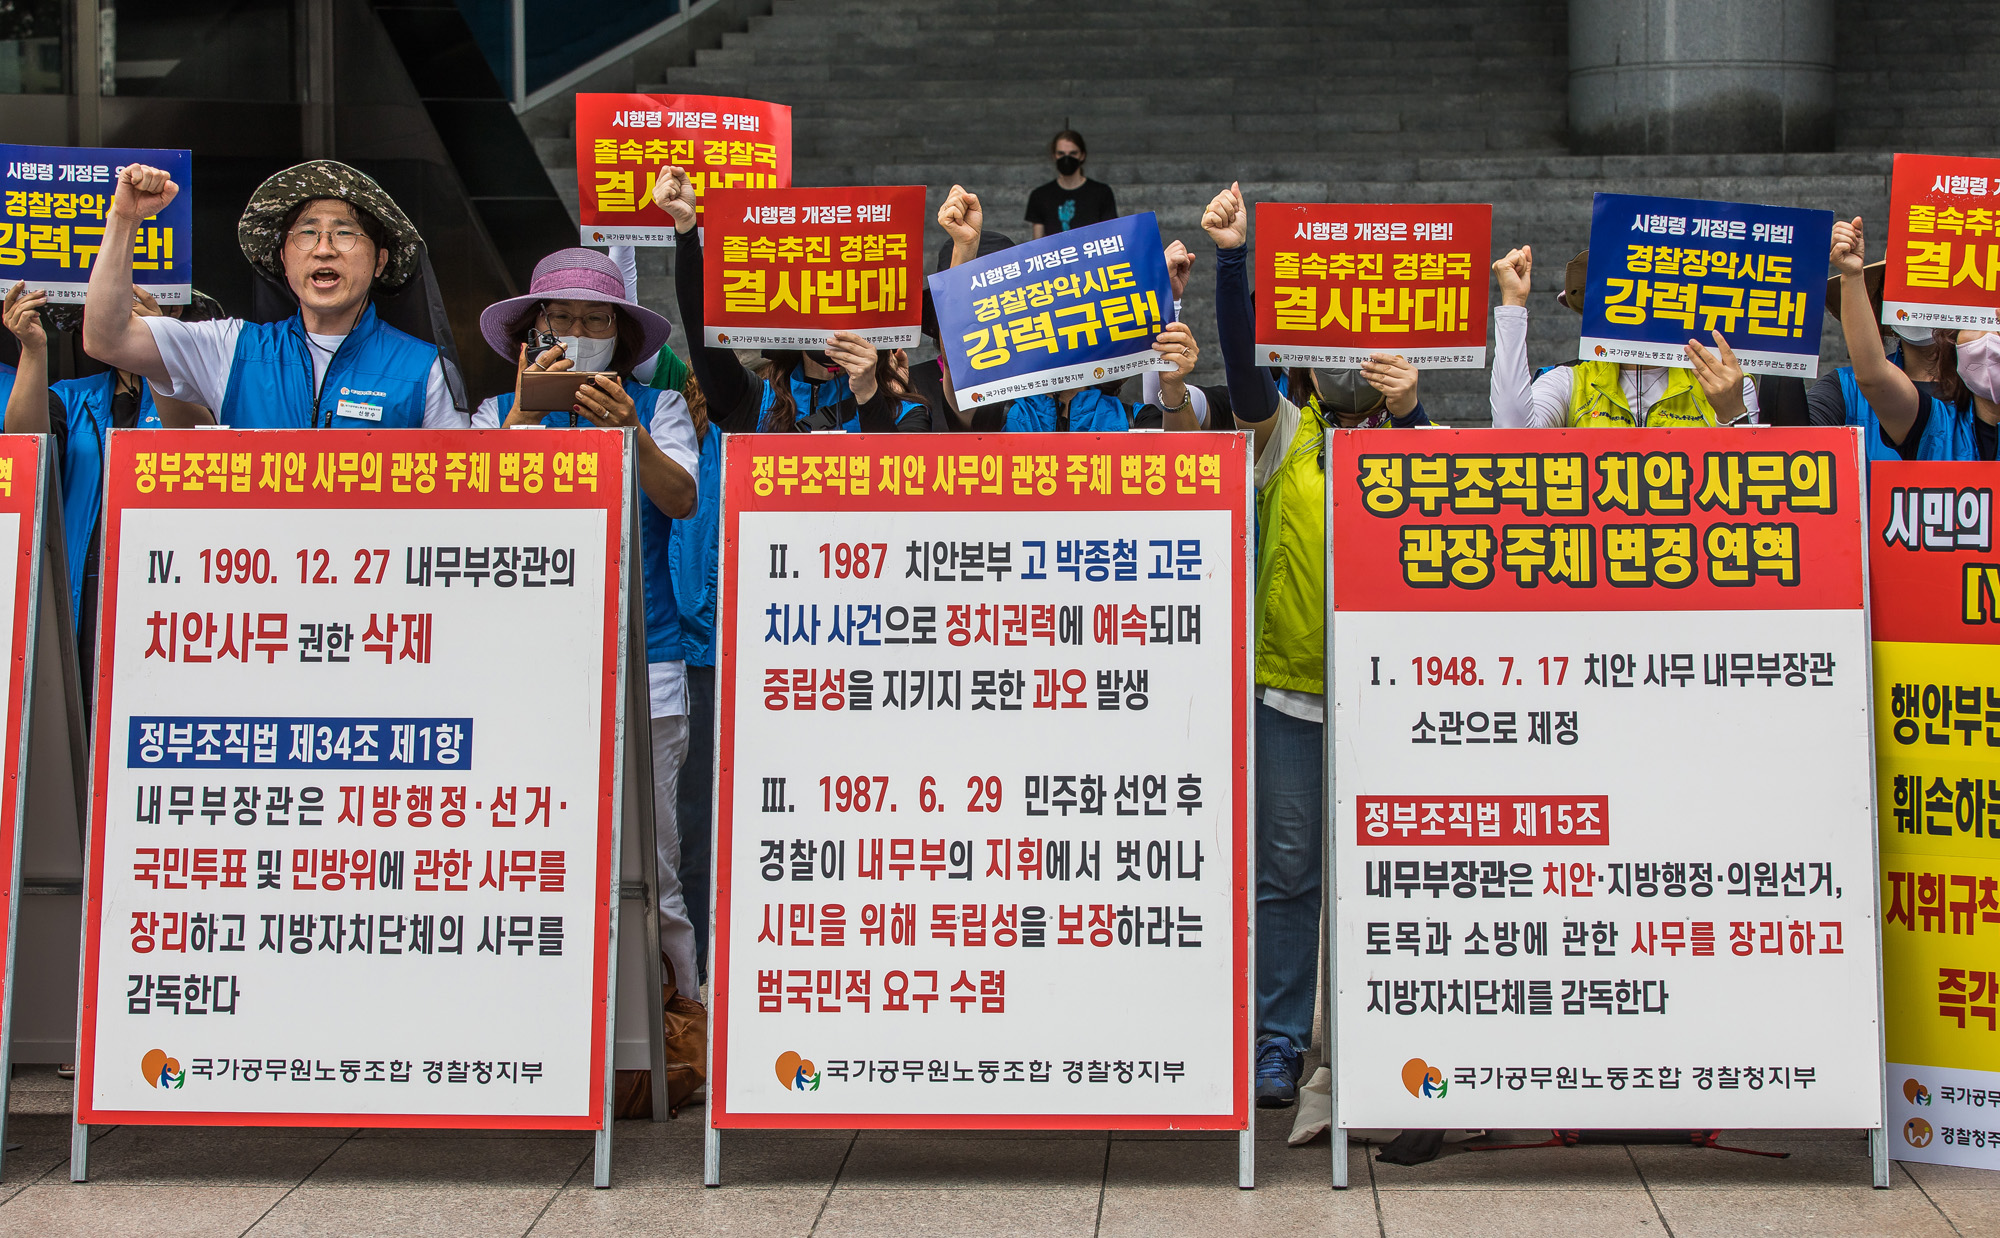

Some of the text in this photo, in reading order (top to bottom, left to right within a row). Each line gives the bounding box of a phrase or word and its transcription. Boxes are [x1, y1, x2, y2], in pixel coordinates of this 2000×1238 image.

[613, 111, 759, 132] 시행령 개정은 위법!
[7, 162, 53, 181] 시행령
[59, 165, 109, 182] 개정은
[594, 139, 777, 169] 졸속추진 경찰국
[1931, 175, 1988, 195] 시행령
[5, 191, 156, 220] 경찰장악
[743, 205, 891, 224] 시행령 개정은 위법!
[1908, 205, 2000, 237] 졸속추
[723, 234, 907, 263] 졸속추진 경찰국
[1295, 222, 1452, 240] 시행령 개정은 위법!
[1631, 214, 1794, 244] 시행령 개정은 위법!
[970, 235, 1125, 290] 시행령 개정은 위법!
[1274, 252, 1471, 280] 졸속추진 경찰국
[1626, 245, 1792, 283] 경찰장악시도
[724, 267, 906, 314] 결사반대!
[973, 262, 1136, 323] 경찰장악시도
[1275, 287, 1469, 332] 결사반대!
[1605, 278, 1807, 338] 강력규탄!
[798, 337, 827, 345] 경찰청지
[963, 290, 1161, 370] 강력규탄!
[135, 452, 598, 493] 정부조직법 치안 사무의 관장 주체 변경 연혁
[752, 454, 1220, 496] 정부조직법 치안 사무의 관장 주체 변경 연혁
[1361, 454, 1833, 514] 정부조직법 치안 사무의
[1885, 492, 1989, 547] 시민의
[200, 549, 277, 584] 1990.
[297, 549, 337, 583] 12.
[354, 549, 390, 584] 27
[406, 547, 575, 587] 내무부장관의
[820, 543, 887, 579] 1987
[906, 541, 1011, 582] 치안본부
[1021, 541, 1046, 579] 고
[1057, 539, 1137, 582] 박종철
[1148, 540, 1202, 580] 고문
[1402, 525, 1796, 586] 관장 주체 변경 연혁
[145, 611, 432, 664] 치안사무 권한 삭제
[765, 603, 1200, 646] 치사 사건으로 정치권력에 예속되며
[764, 669, 1148, 711] 중립성을 지키지 못한 과오 발생
[1412, 656, 1484, 686] 1948.
[1499, 657, 1522, 685] 7.
[1539, 657, 1568, 685] 17
[1584, 653, 1636, 687] 치안
[1644, 654, 1695, 687] 사무
[1704, 653, 1836, 687] 내무부장관
[140, 723, 463, 764] 정부조직법 제34조 제1항
[1412, 711, 1578, 745] 소관으로 제정
[136, 786, 324, 825] 내무부장관은
[820, 776, 896, 812] 1987.
[920, 776, 944, 812] 6.
[967, 776, 1002, 812] 29
[1025, 774, 1107, 816] 민주화
[1114, 775, 1166, 815] 선언
[1177, 774, 1202, 816] 후
[1365, 803, 1601, 837] 정부조직법 제15조
[134, 848, 566, 892] 국민투표 및 민방위에 관한 사무를
[760, 837, 1204, 881] 경찰이 내무부의 지휘에서 벗어나
[1366, 861, 1533, 898] 내무부장관은
[131, 912, 564, 956] 장리하고 지방자치단체의 사무를
[758, 903, 1202, 947] 시민을 위해 독립성을 보장하라는
[1367, 920, 1844, 956] 토목과 소방에 관한 사무를 장리하고
[127, 974, 240, 1015] 감독한다
[758, 970, 1004, 1013] 범국민적 요구 수렴
[1367, 979, 1669, 1015] 지방자치단체를 감독한다
[1938, 968, 1999, 1031] 즉각
[192, 1059, 542, 1084] 국가공무원노동조합 경찰청지부
[827, 1060, 1184, 1084] 국가공무원노동조합 경찰청지부
[1454, 1066, 1816, 1090] 국가공무원노동조합 경찰청지부
